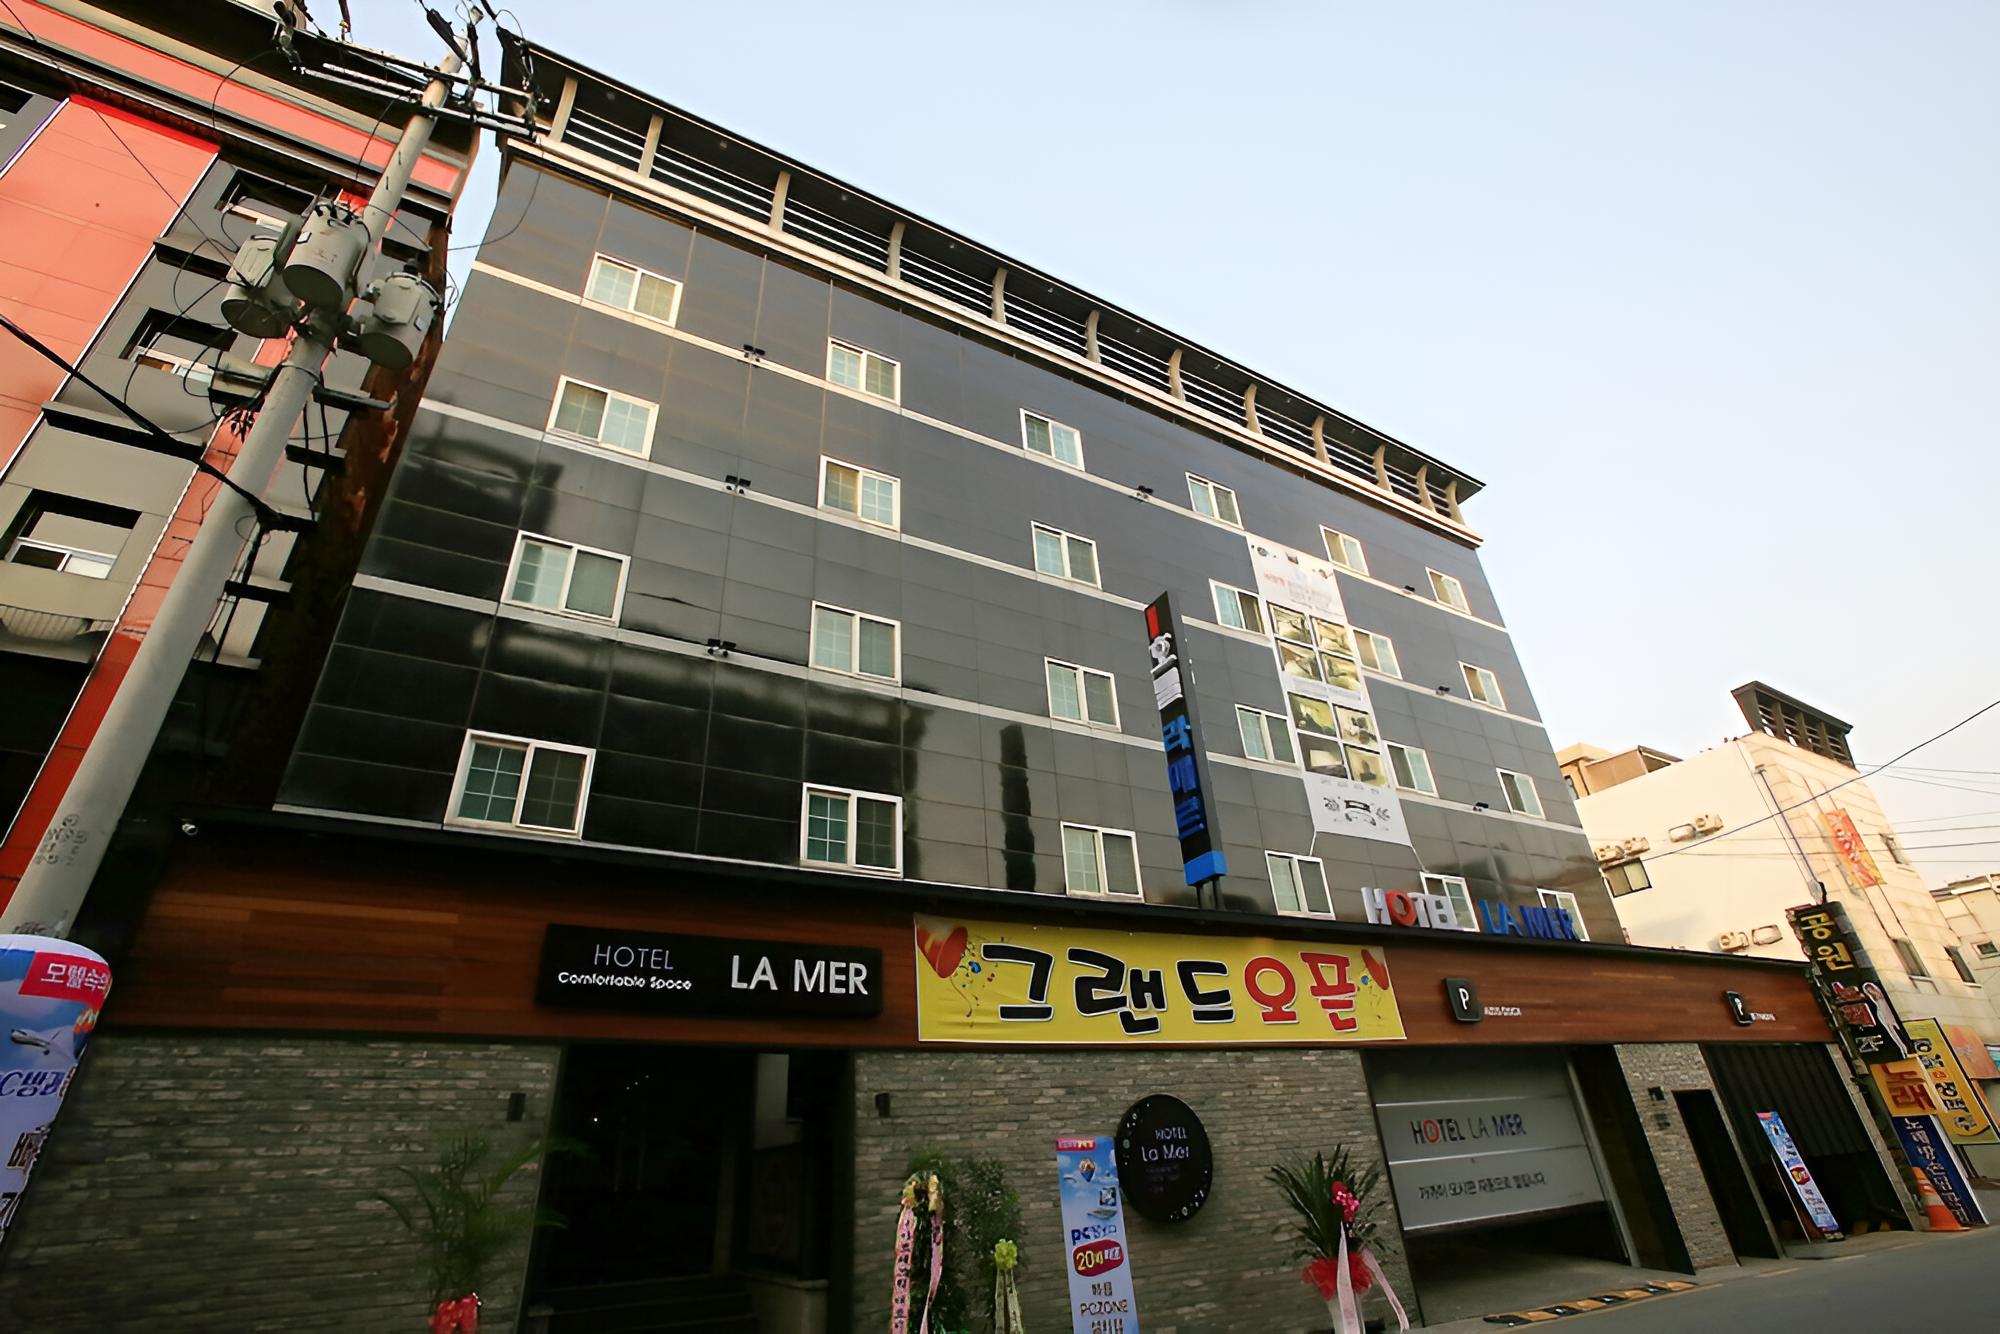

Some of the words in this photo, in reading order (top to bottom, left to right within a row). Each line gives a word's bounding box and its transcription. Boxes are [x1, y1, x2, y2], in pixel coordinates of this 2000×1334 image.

[1361, 886, 1460, 930] HOTEL
[1478, 899, 1524, 936] LA
[1519, 905, 1581, 941] MER
[594, 944, 674, 970] HOTEL
[1800, 912, 1855, 971] 공원
[558, 972, 646, 988] Comfortable
[650, 975, 692, 990] Space
[731, 955, 778, 991] LA
[793, 958, 868, 995] MER
[1459, 987, 1469, 1010] P
[1410, 1118, 1466, 1144] HOTEL
[1468, 1118, 1489, 1140] LA
[1492, 1113, 1527, 1137] MER
